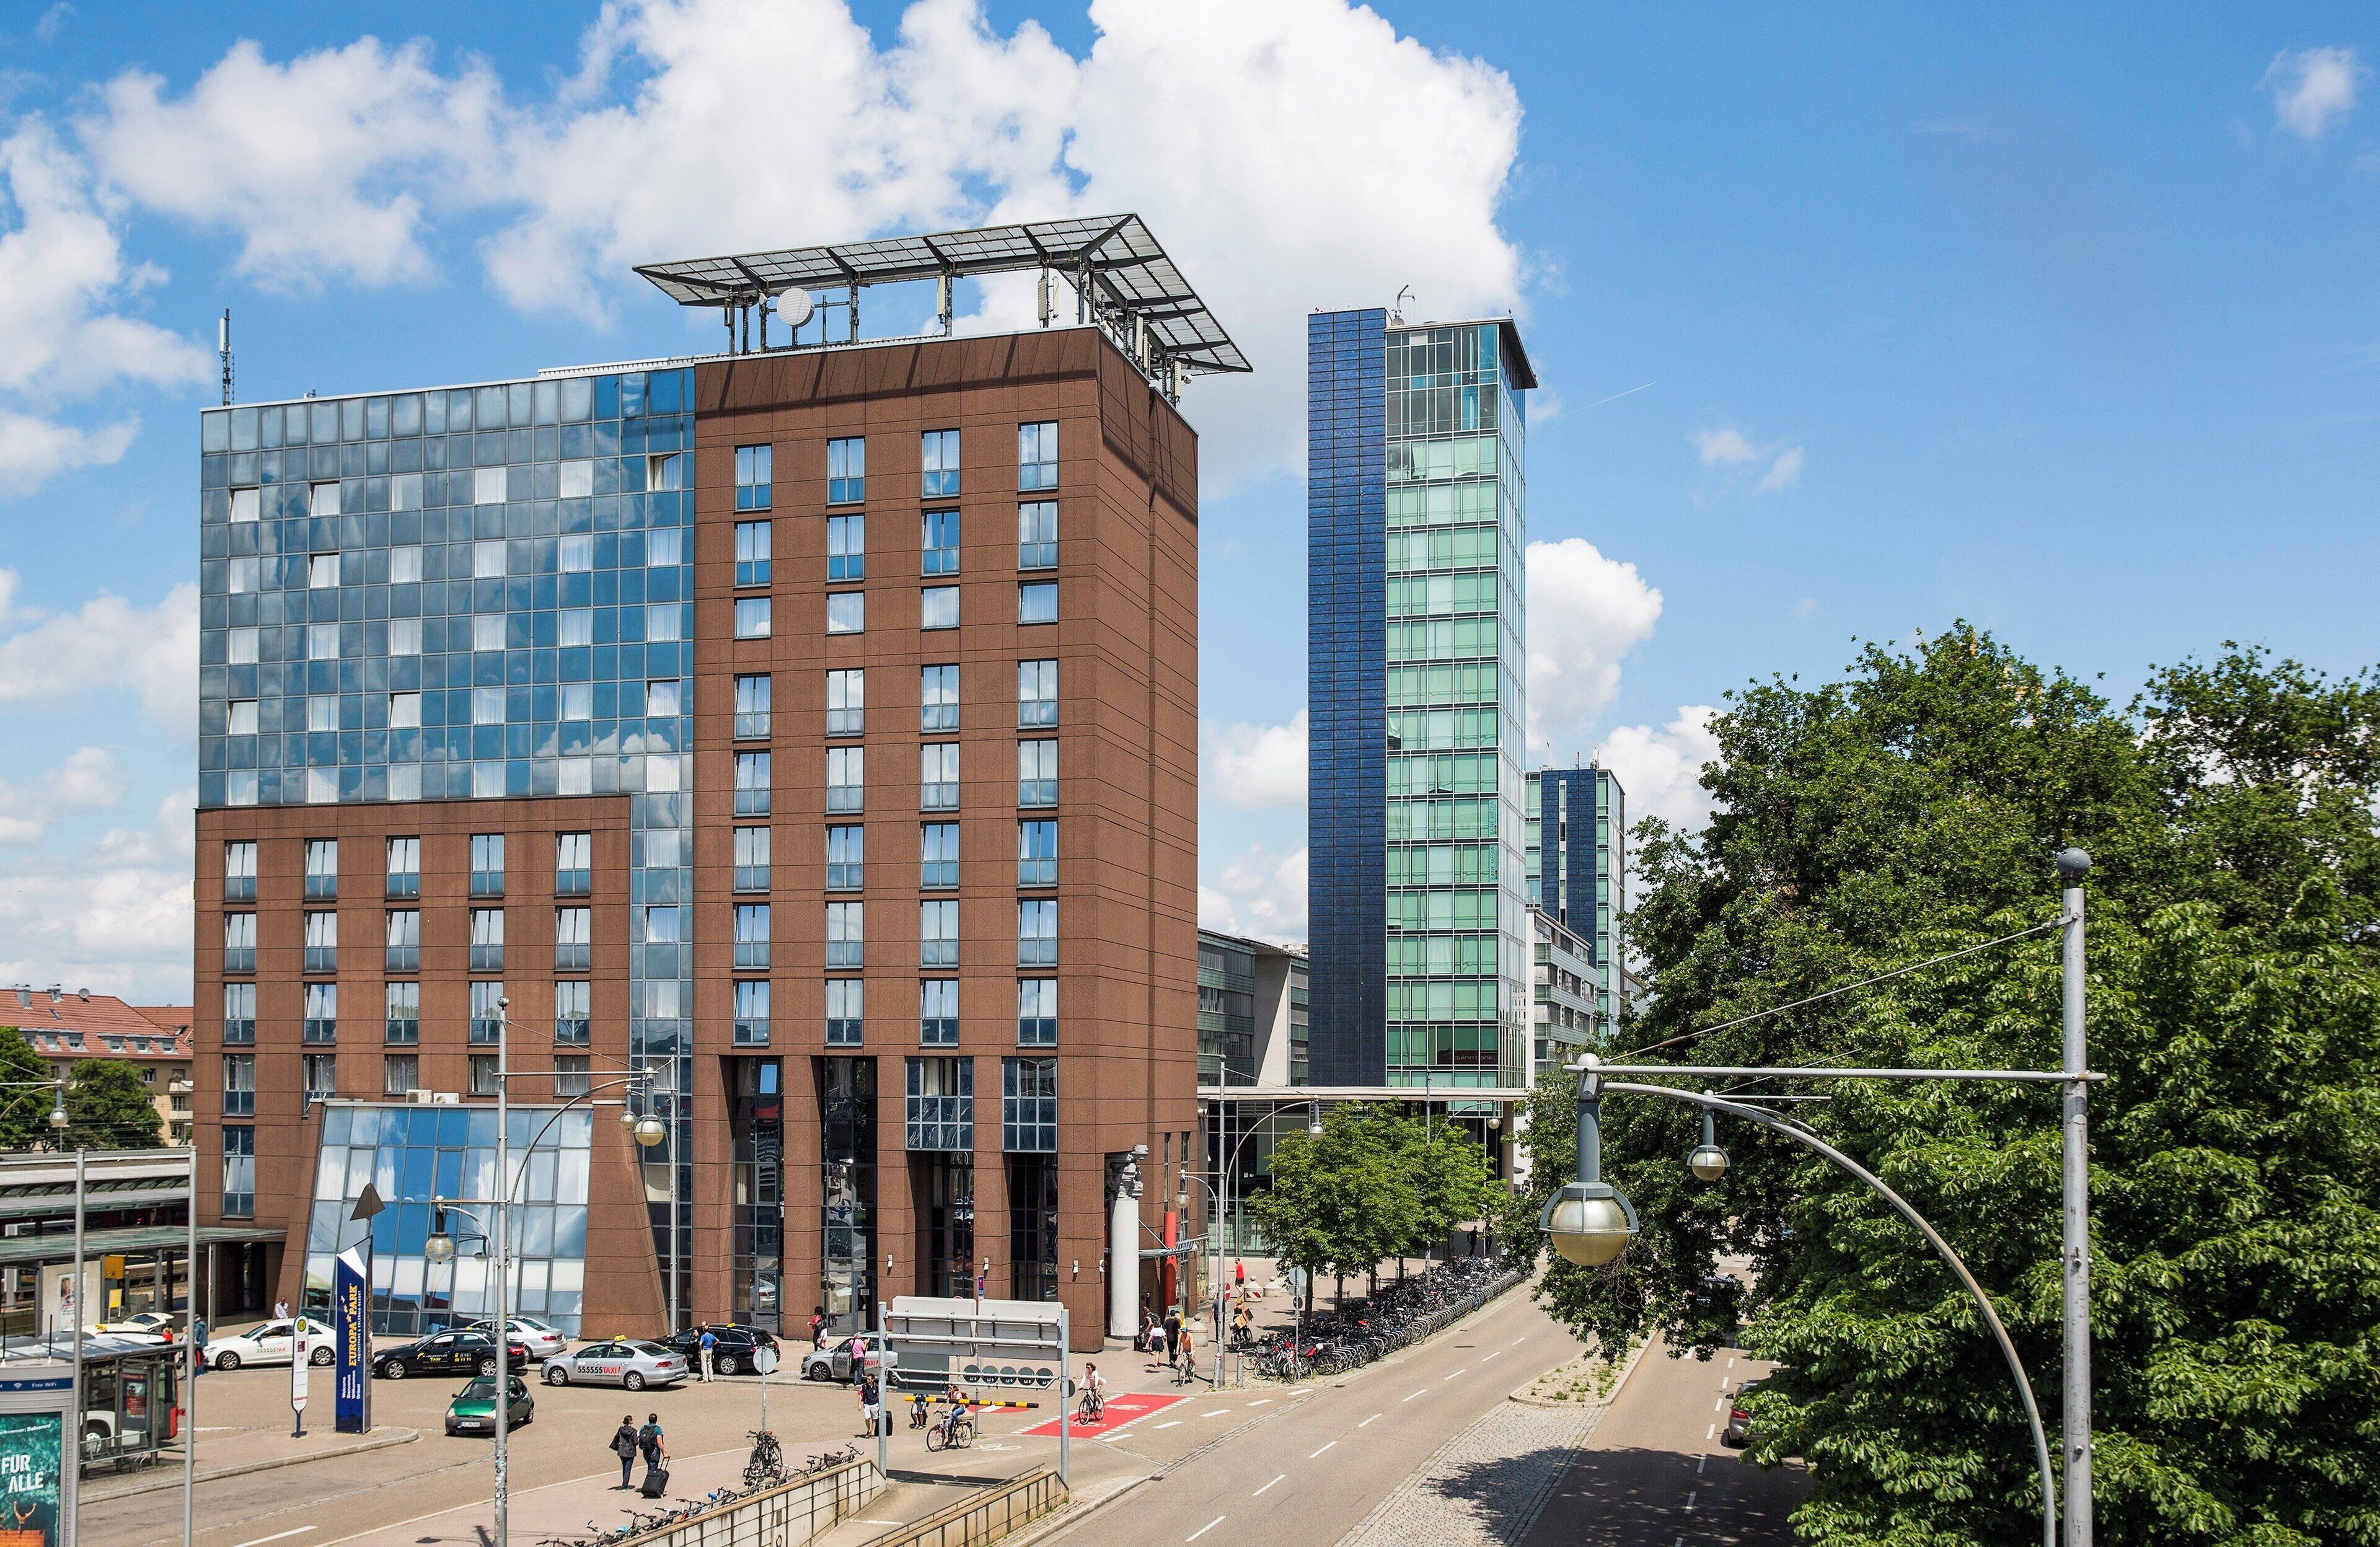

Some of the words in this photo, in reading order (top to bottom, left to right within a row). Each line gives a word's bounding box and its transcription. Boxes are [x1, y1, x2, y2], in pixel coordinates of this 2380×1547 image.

[349, 1285, 358, 1315] PARK
[348, 1321, 357, 1367] EUROPA
[8, 1471, 44, 1494] ALLE
